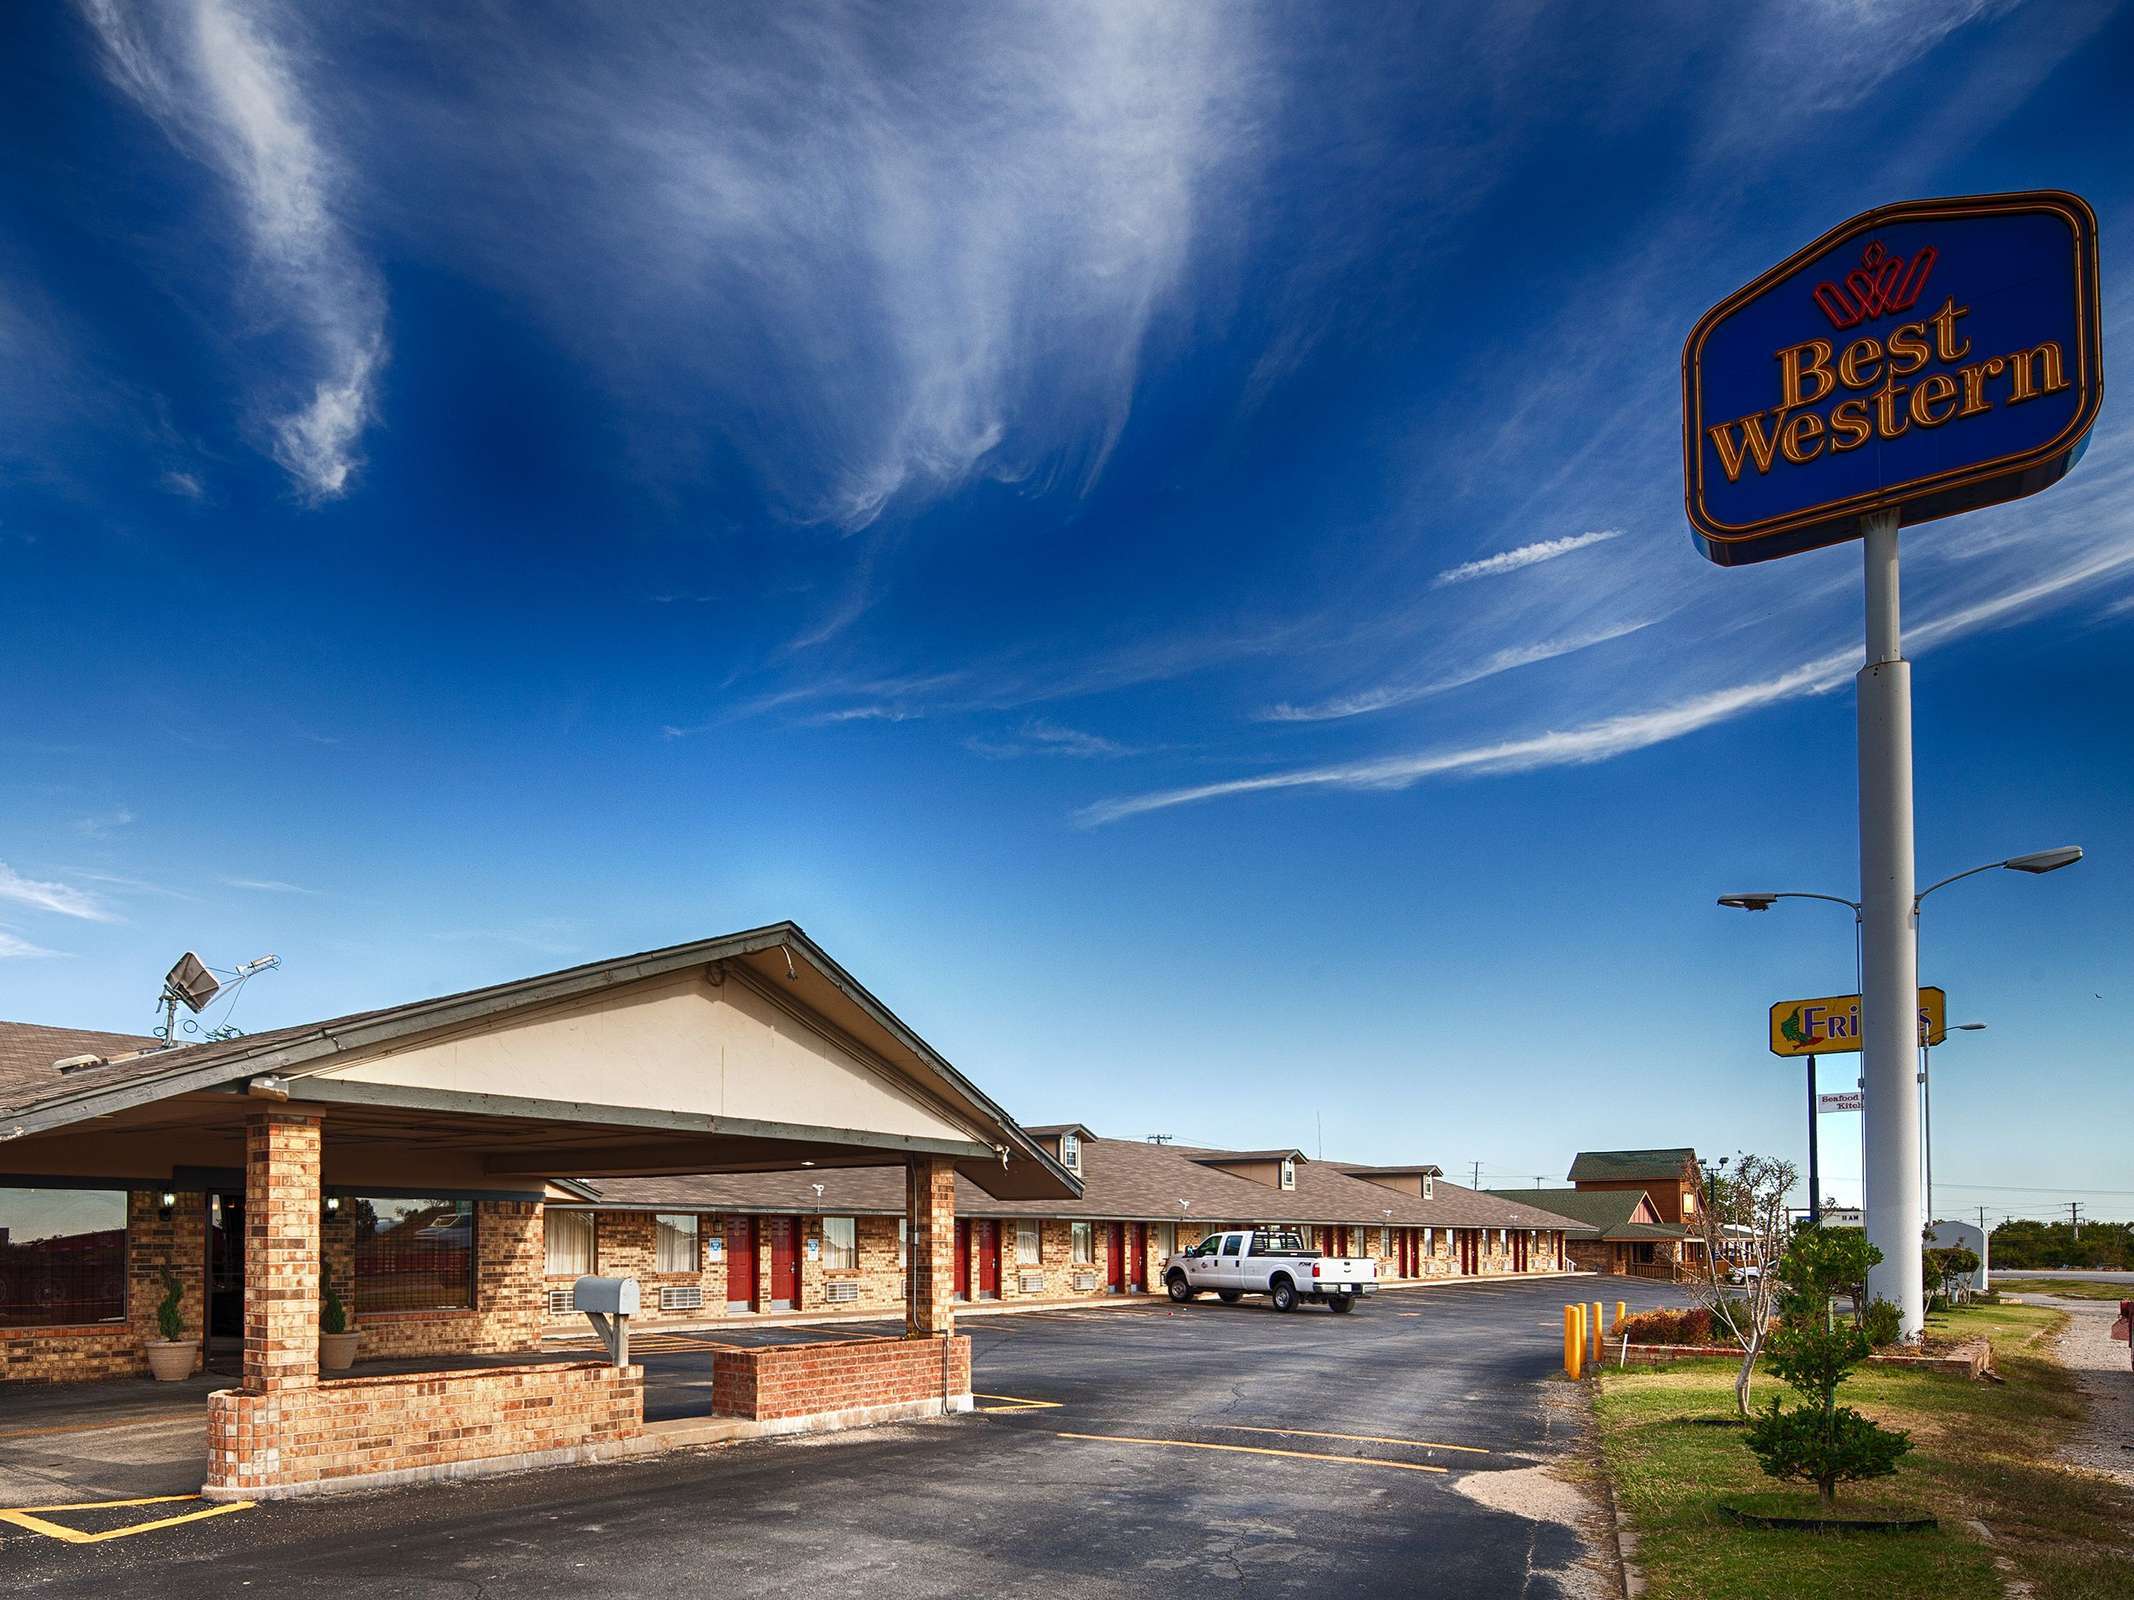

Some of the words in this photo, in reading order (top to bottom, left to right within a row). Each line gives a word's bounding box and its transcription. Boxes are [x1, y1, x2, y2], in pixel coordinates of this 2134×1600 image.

[1775, 297, 1971, 411] Best
[1707, 341, 2071, 483] Western
[1822, 1094, 1859, 1102] Seafood
